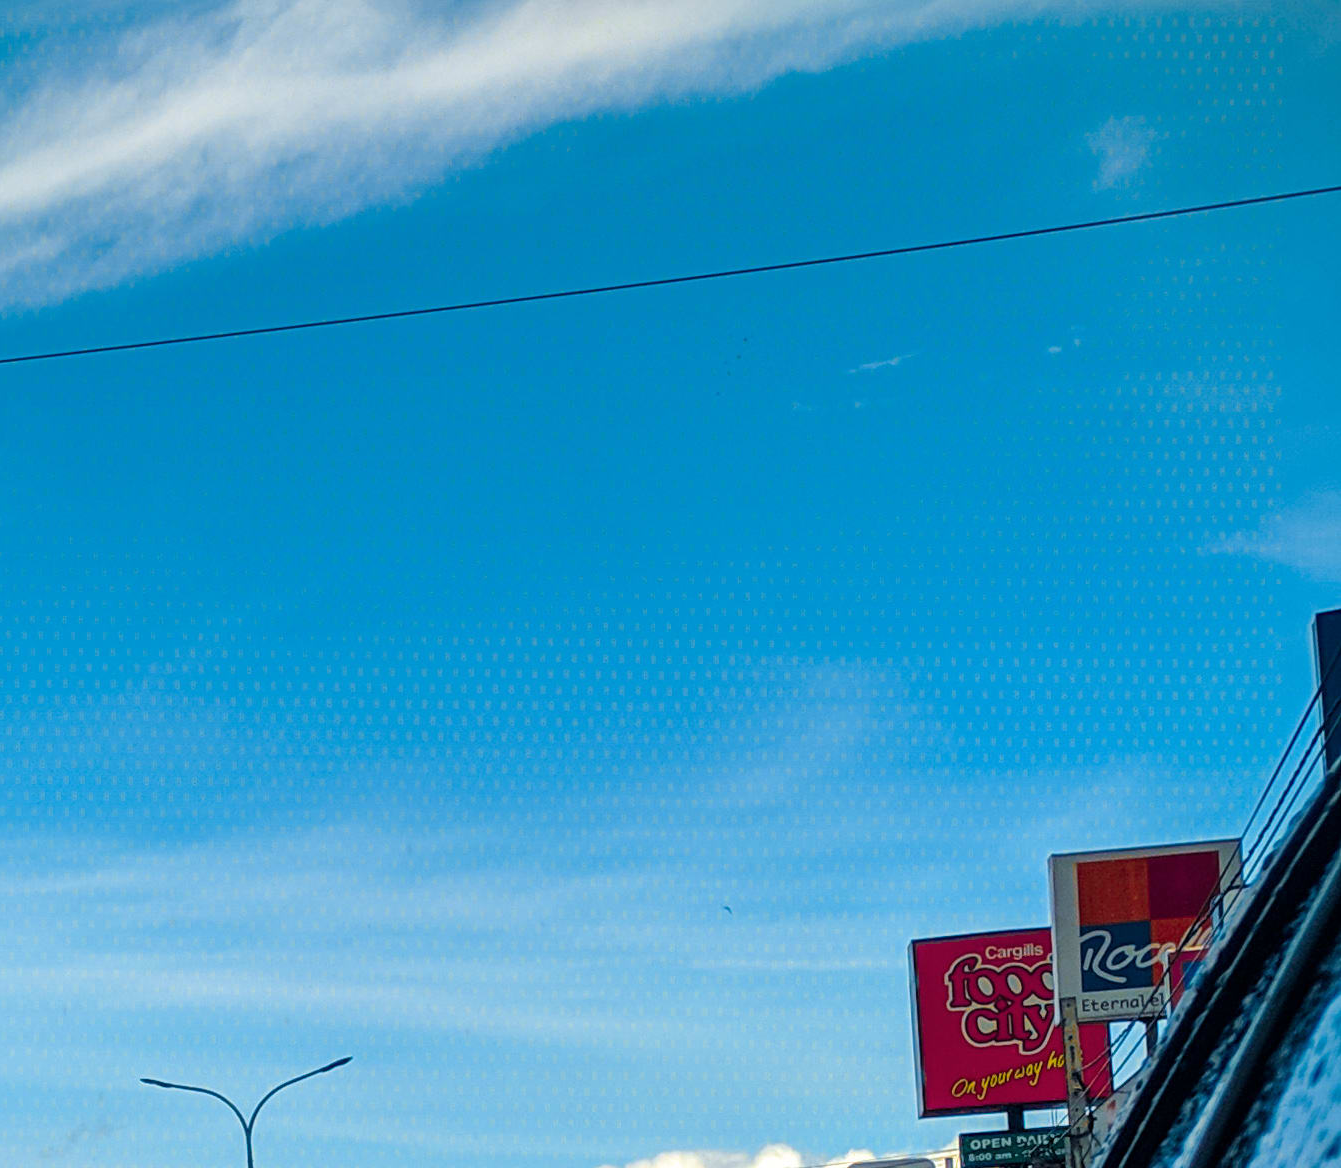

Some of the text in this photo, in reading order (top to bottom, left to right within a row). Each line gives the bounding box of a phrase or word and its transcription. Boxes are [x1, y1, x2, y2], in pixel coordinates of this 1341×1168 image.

[985, 943, 1044, 960] Cargills
[1082, 993, 1143, 1012] Eternal
[952, 1079, 976, 1097] On
[977, 1068, 1012, 1100] your
[1014, 1060, 1043, 1086] way
[970, 1137, 1011, 1150] OPEN
